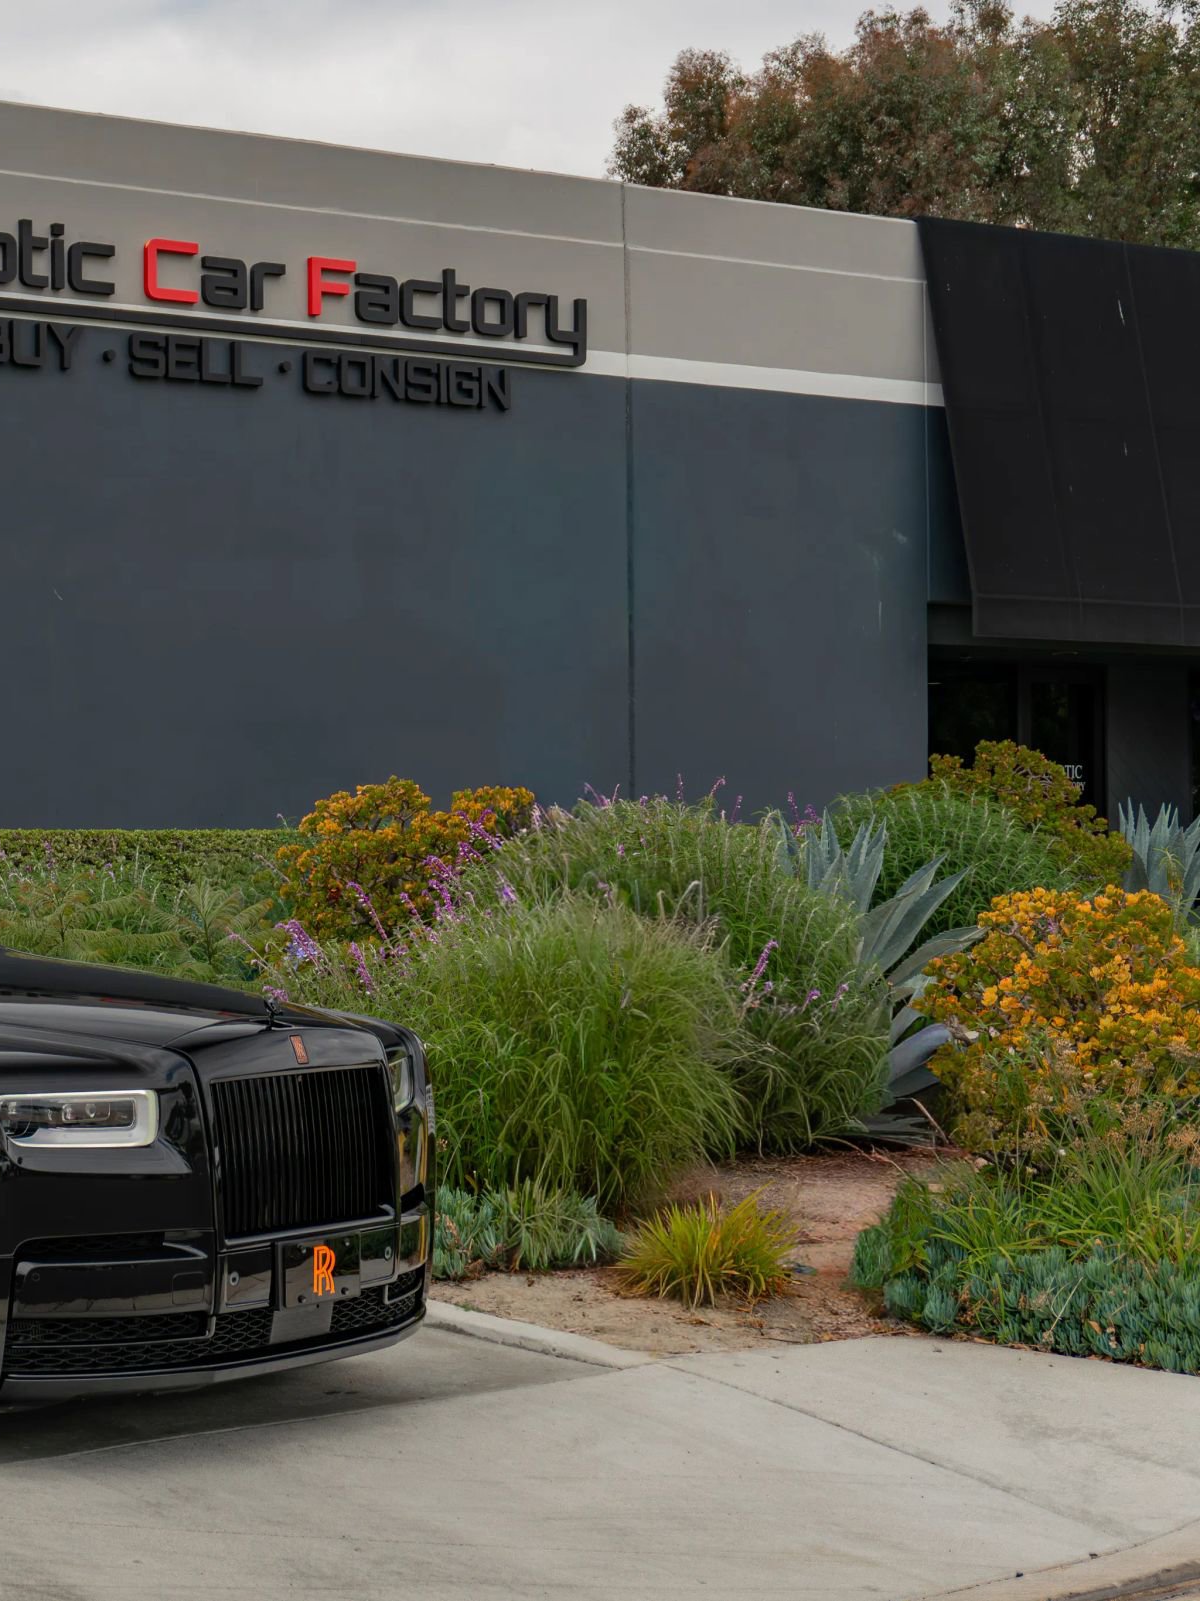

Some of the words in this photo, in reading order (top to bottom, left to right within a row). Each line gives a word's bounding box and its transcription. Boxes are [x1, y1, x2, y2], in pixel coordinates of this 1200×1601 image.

[143, 238, 286, 311] Car
[307, 256, 587, 367] Factory
[128, 332, 263, 388] SELL
[302, 350, 510, 410] CONSIGN
[1064, 764, 1083, 779] TIC
